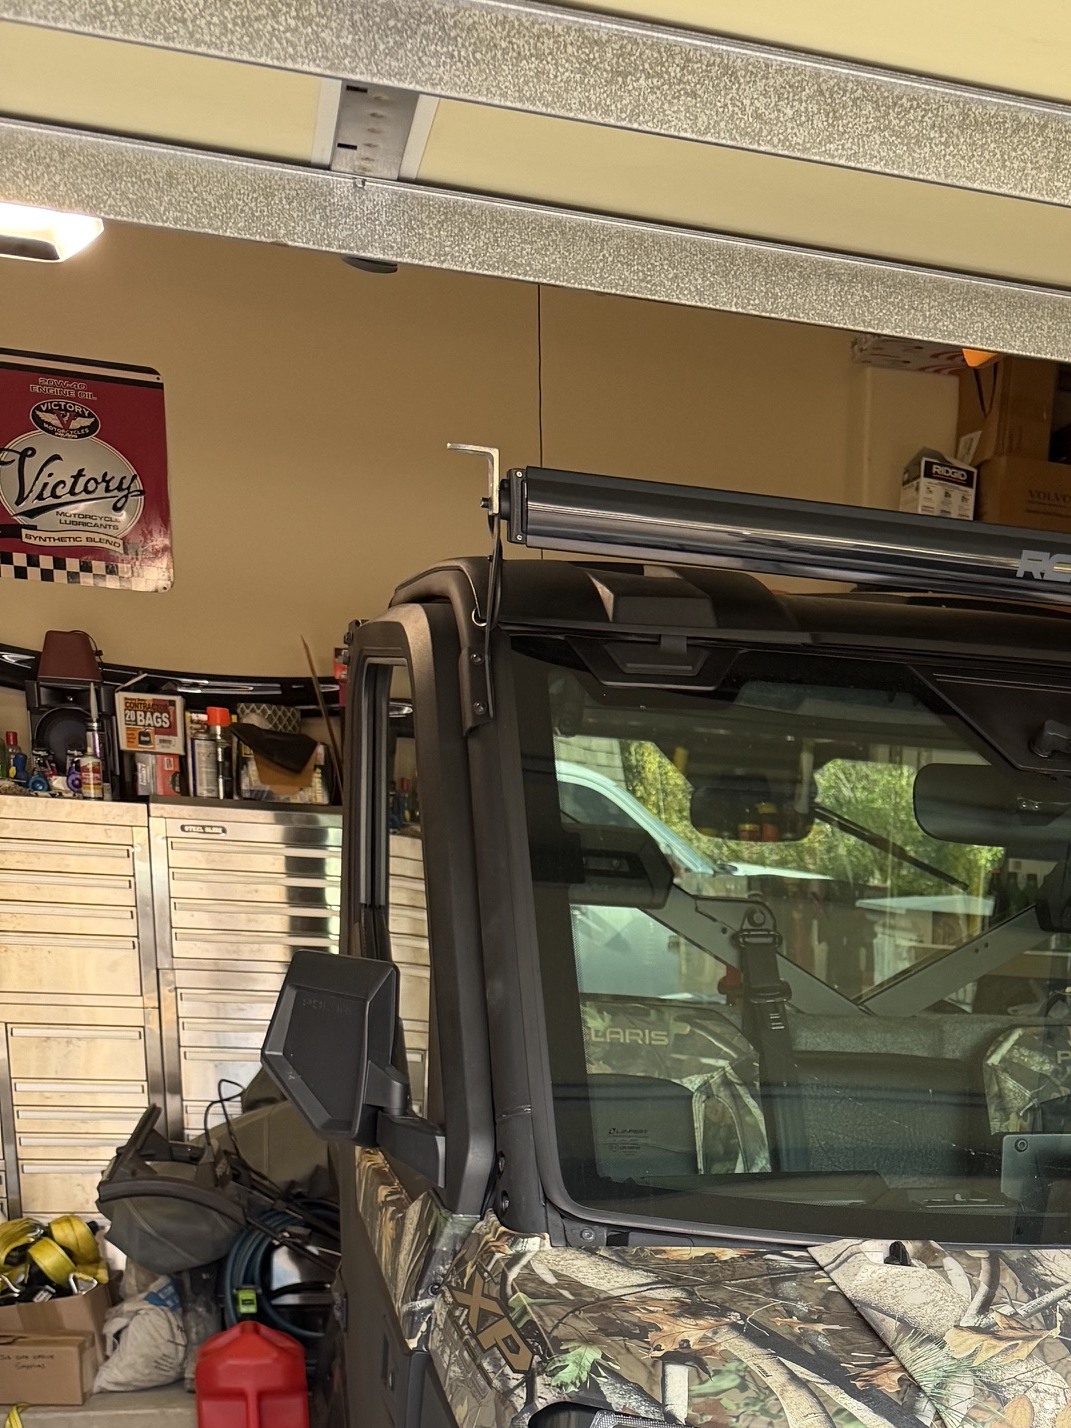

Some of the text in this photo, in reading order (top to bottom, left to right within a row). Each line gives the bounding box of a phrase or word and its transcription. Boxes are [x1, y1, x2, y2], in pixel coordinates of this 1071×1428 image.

[29, 384, 97, 400] ENGINE OIL
[40, 401, 90, 418] VICTORY
[0, 446, 146, 512] Victory
[932, 464, 968, 481] RIDGID
[59, 518, 120, 531] LUBRICANTS
[24, 533, 121, 548] SYNTHETIC BLEND
[125, 710, 171, 729] 20 BAGS
[446, 1264, 534, 1374] XP
